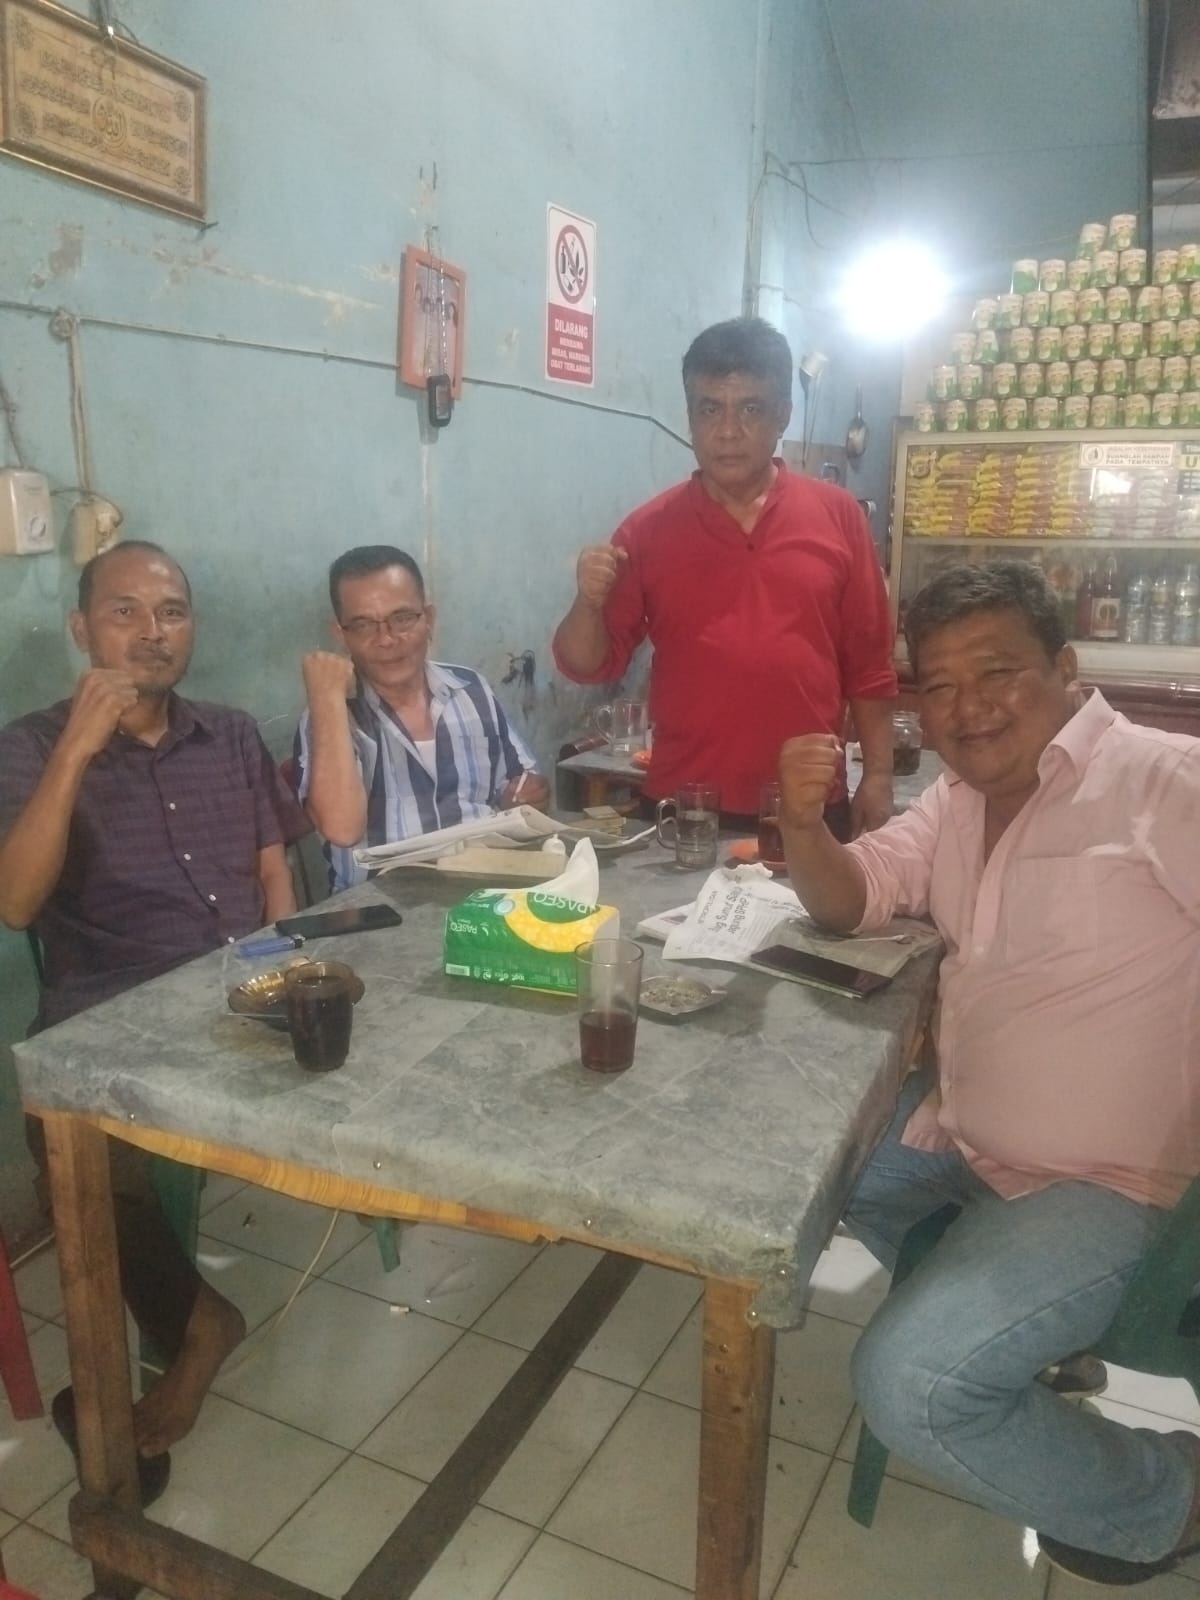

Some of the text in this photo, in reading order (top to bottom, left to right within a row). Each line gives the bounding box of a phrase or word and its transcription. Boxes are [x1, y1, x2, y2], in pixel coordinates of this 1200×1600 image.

[554, 318, 588, 339] DILARANG
[550, 359, 592, 375] OBAT TERLARANG
[450, 921, 478, 934] PASEO
